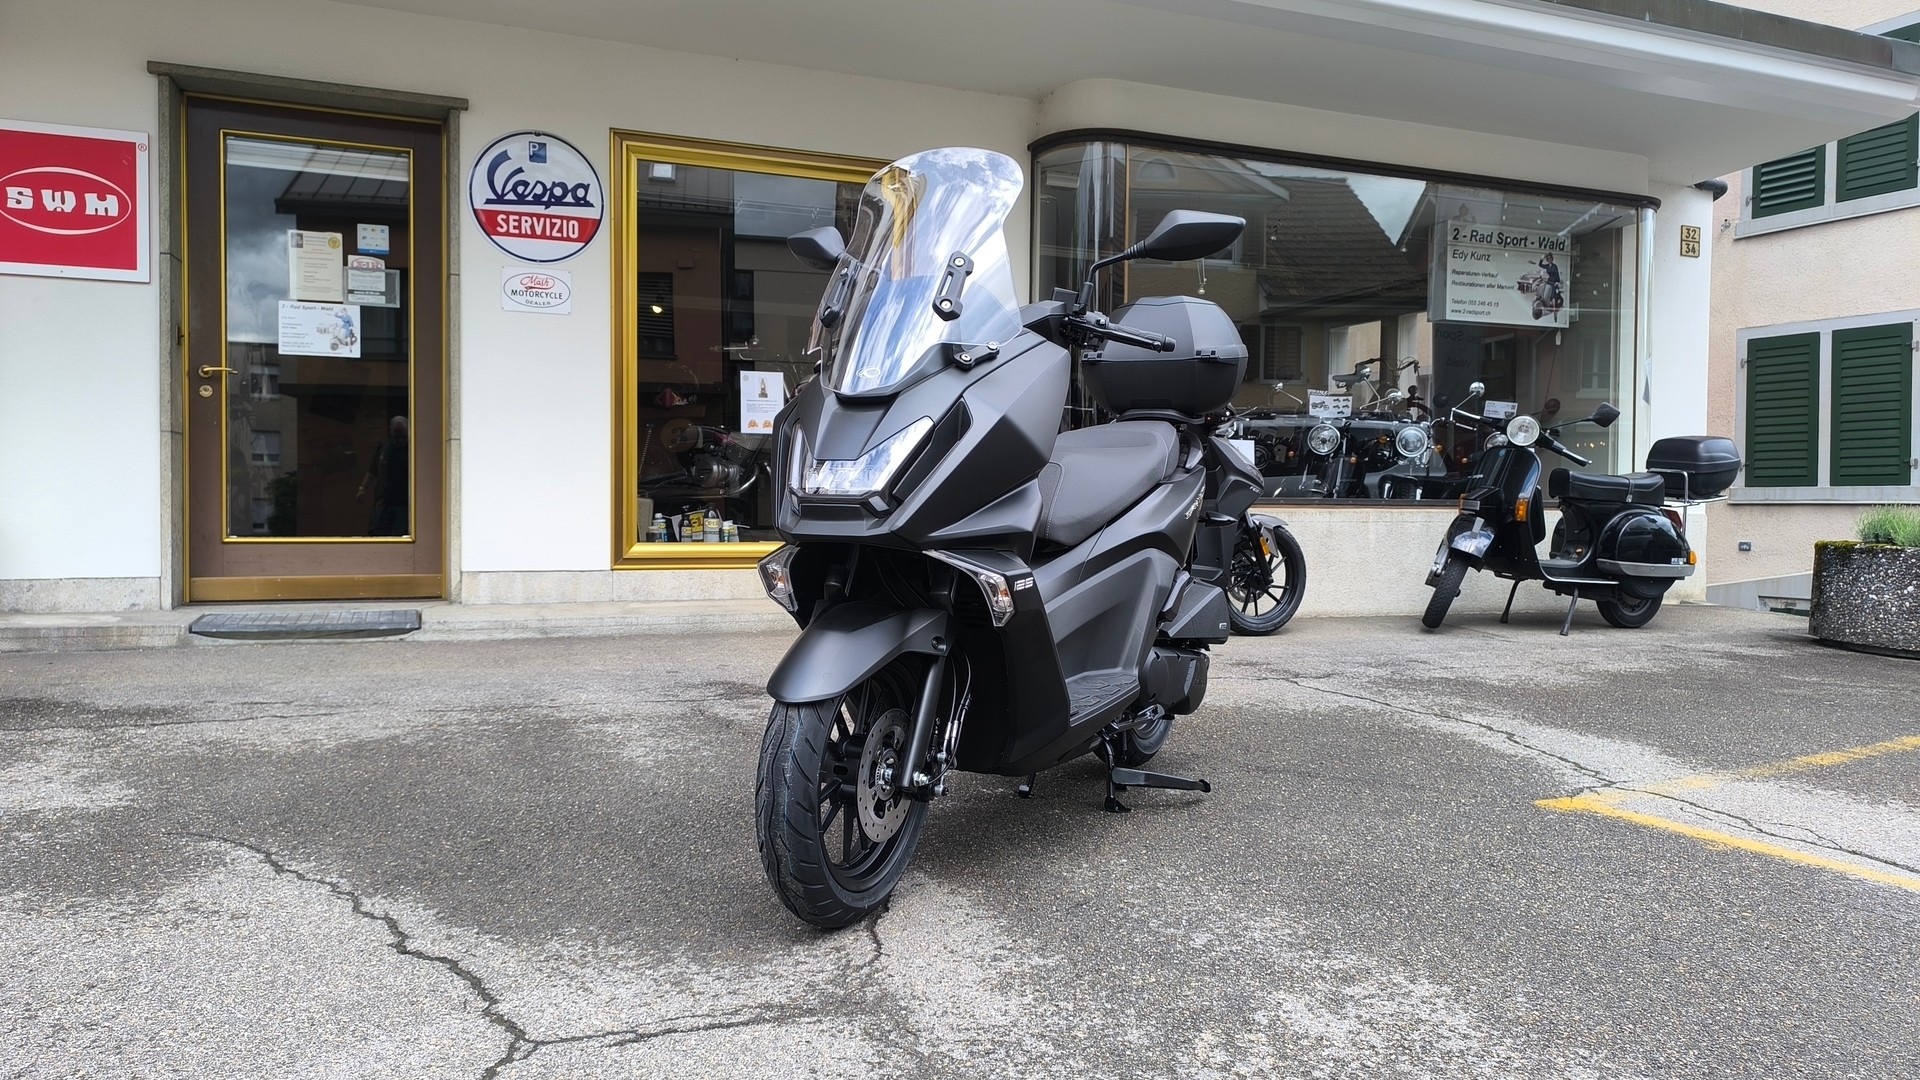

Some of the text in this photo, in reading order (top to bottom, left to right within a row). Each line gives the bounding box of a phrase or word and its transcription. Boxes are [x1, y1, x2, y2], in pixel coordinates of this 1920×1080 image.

[483, 149, 595, 210] Vespa
[6, 186, 119, 217] SWM
[496, 213, 579, 239] SERVIZIO
[1452, 228, 1460, 240] 2
[1469, 229, 1494, 244] Rad
[1496, 232, 1528, 248] Sport
[1538, 236, 1566, 251] Wald
[1685, 227, 1697, 240] 32
[1452, 249, 1491, 262] Edy Kunz
[1685, 242, 1696, 255] 34
[520, 275, 555, 290] Mash
[511, 288, 563, 300] MOTORCYCLE
[1451, 298, 1467, 306] Telefon
